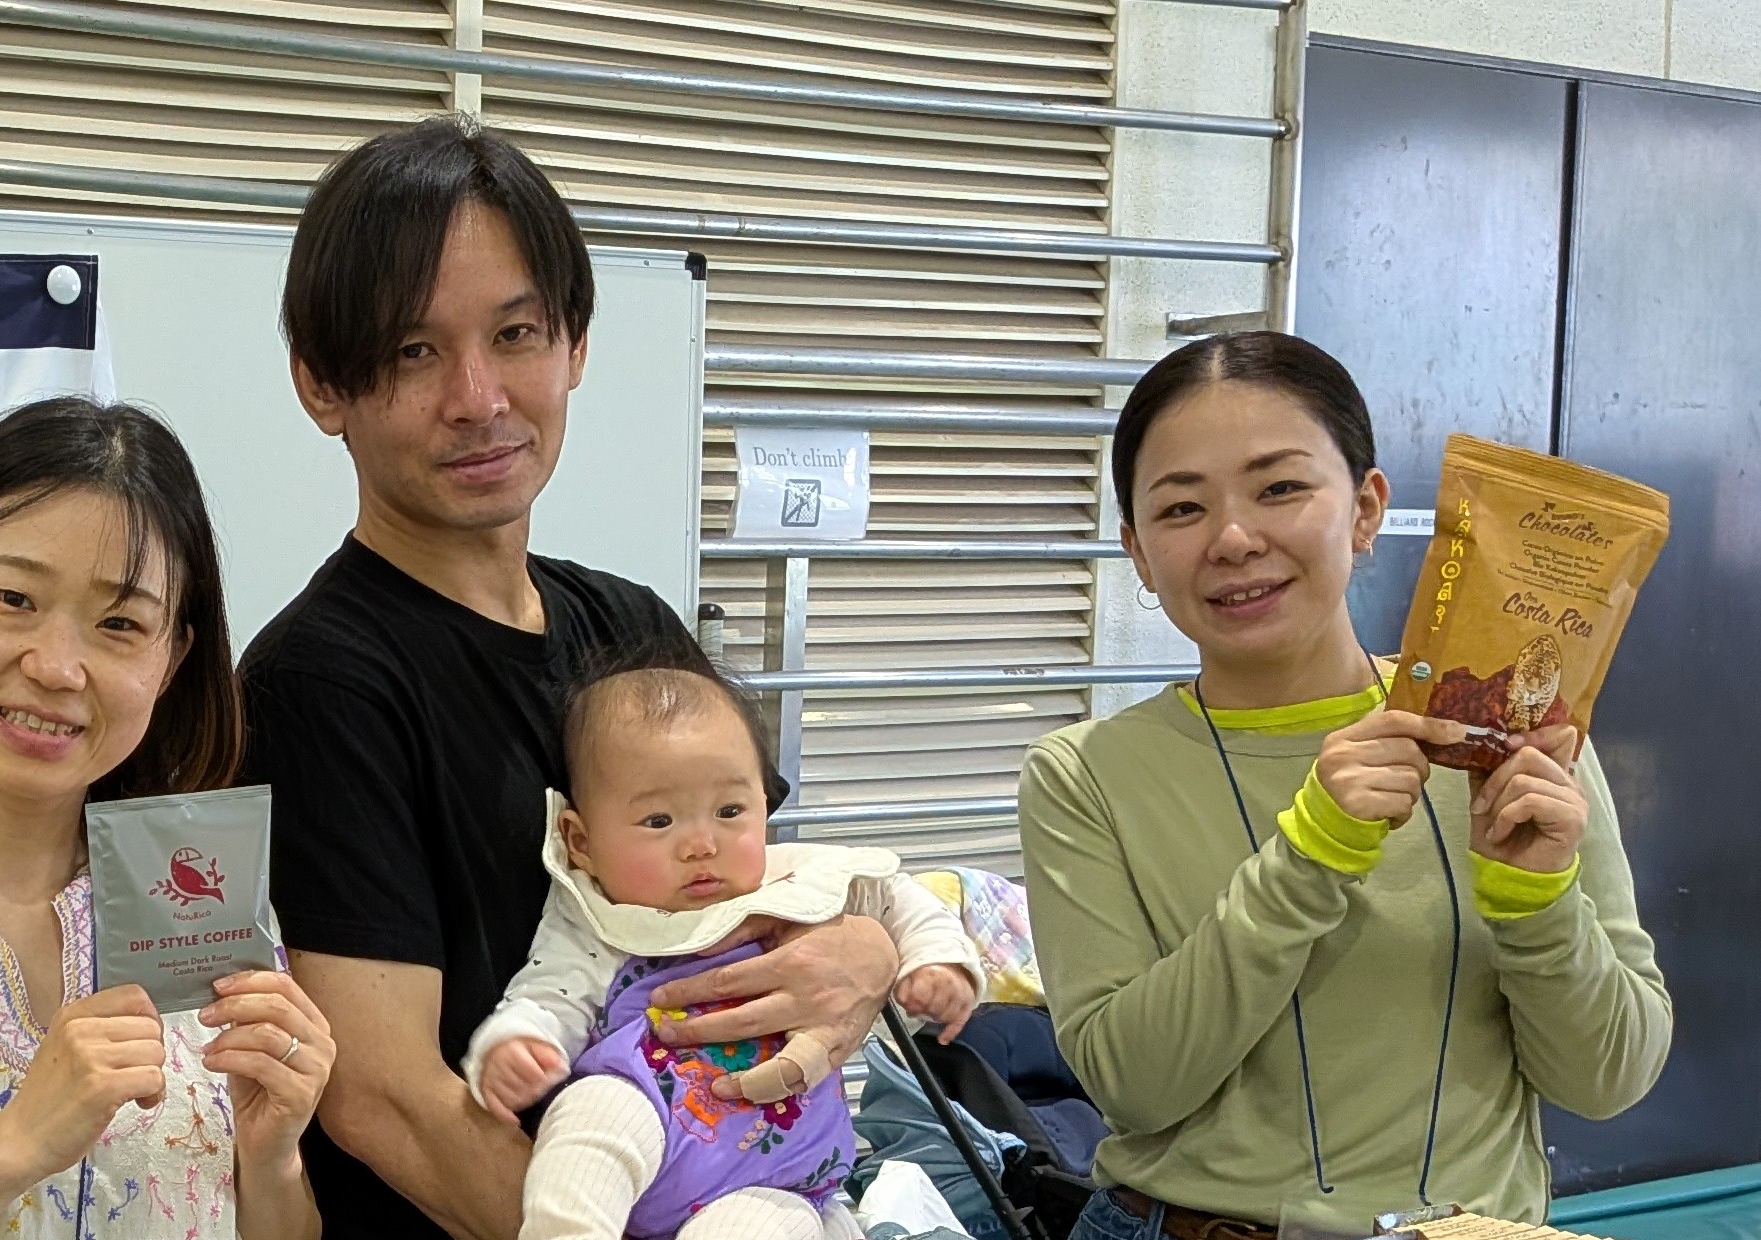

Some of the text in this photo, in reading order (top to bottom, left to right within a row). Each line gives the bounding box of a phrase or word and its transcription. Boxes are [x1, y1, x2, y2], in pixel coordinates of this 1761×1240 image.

[753, 446, 848, 467] Don't climb
[1518, 511, 1613, 549] Chocolates
[1502, 592, 1593, 638] Costa Rica
[129, 927, 253, 952] DIP STYLE COFFEE
